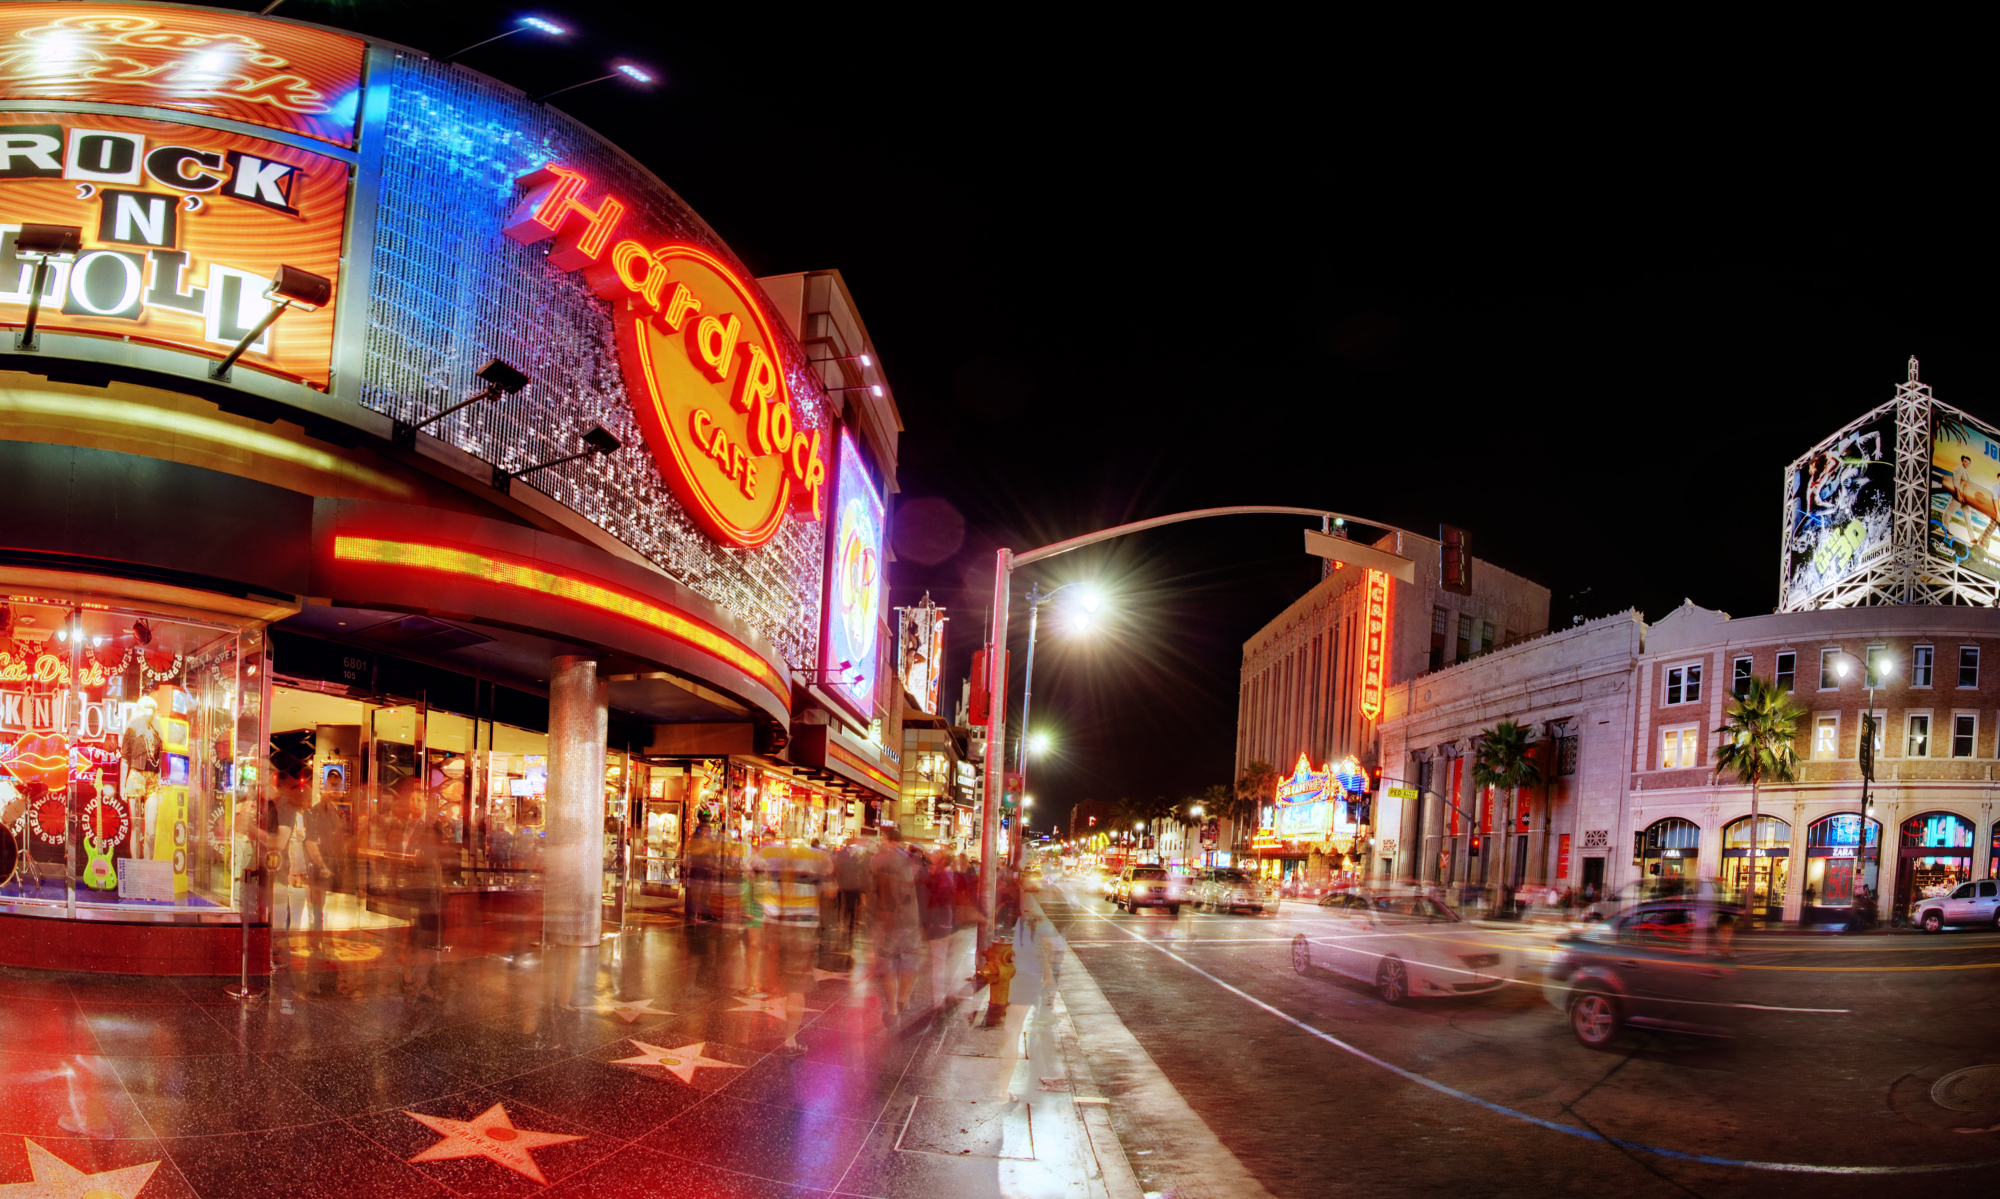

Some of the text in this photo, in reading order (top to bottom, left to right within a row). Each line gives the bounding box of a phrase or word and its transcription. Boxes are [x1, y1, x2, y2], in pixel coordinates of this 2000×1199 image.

[533, 162, 824, 521] Hard Rock
[688, 408, 757, 500] CAFE
[1861, 547, 1884, 564] AUGUST
[1885, 545, 1890, 553] 6
[1366, 587, 1384, 704] CAPITAN
[35, 654, 105, 686] Drnk
[343, 656, 367, 672] 6801
[343, 670, 356, 680] 105
[82, 813, 95, 838] RED
[102, 795, 128, 818] CHILI
[956, 807, 973, 827] TMZ
[1746, 849, 1766, 857] ZRA
[1833, 848, 1854, 856] ZARA
[1828, 866, 1849, 899] 50
[435, 1119, 486, 1145] NEWTON
